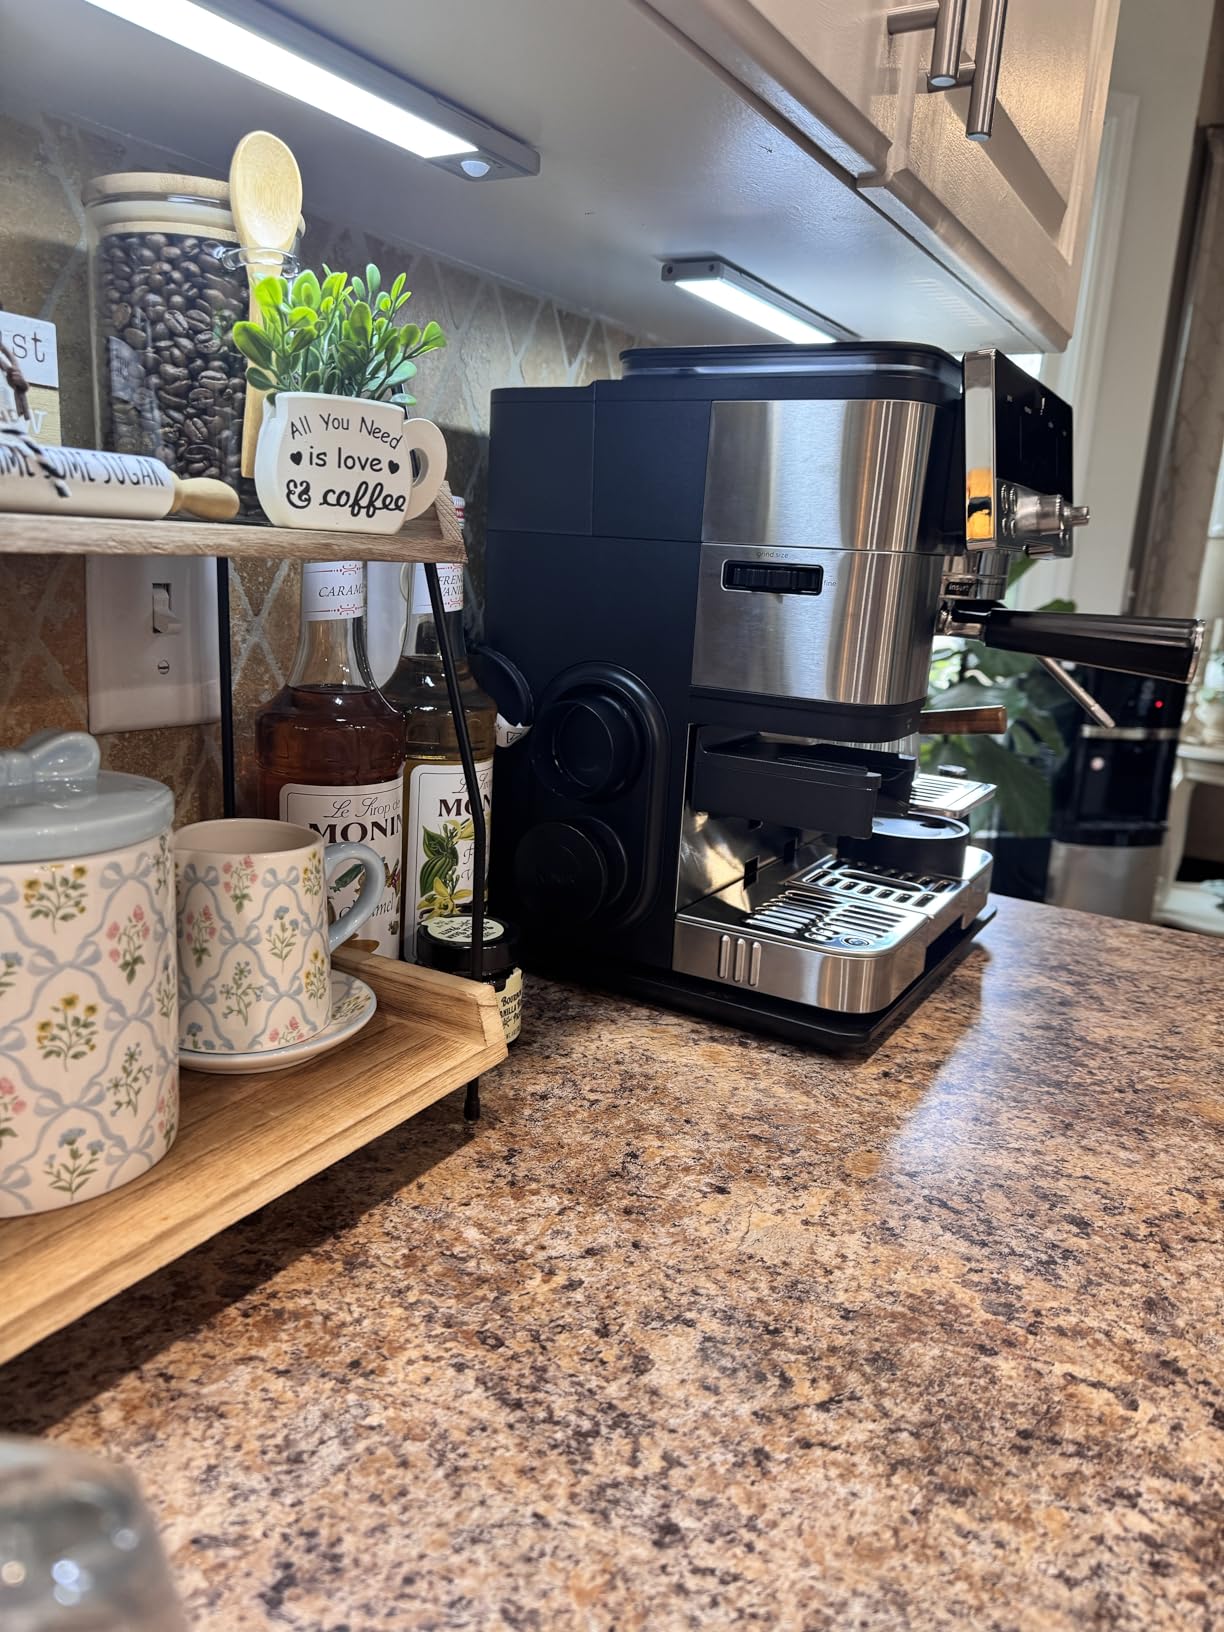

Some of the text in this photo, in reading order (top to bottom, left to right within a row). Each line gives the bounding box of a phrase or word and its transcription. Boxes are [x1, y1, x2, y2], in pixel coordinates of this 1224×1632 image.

[290, 412, 403, 450] All You Need
[93, 453, 165, 487] SUGAR
[309, 445, 383, 472] is love
[286, 479, 406, 518] & coffee
[318, 583, 364, 598] CARAM
[438, 575, 464, 586] FREN
[323, 799, 352, 818] Le
[355, 796, 391, 818] Sirop
